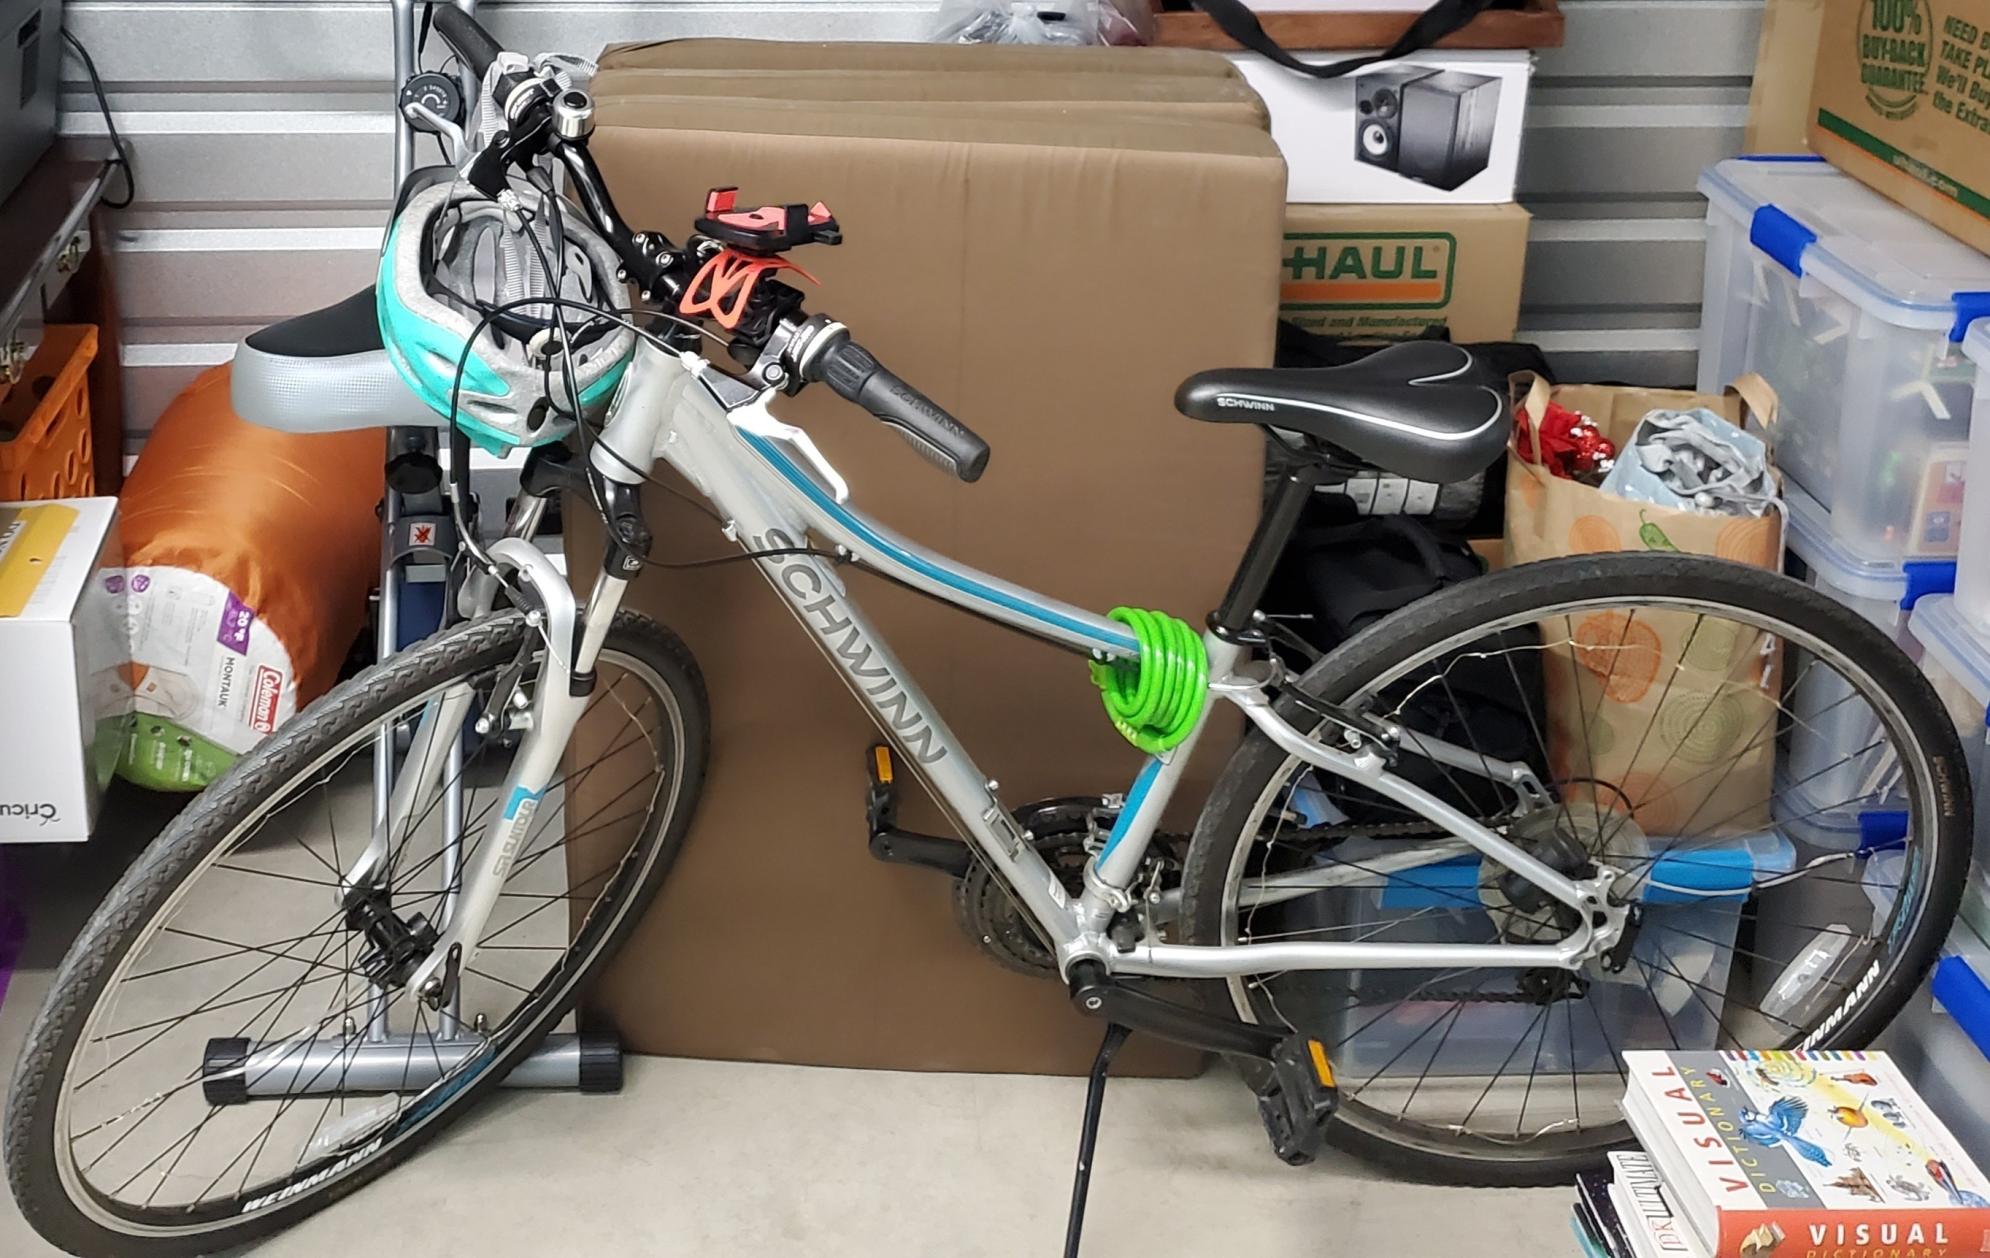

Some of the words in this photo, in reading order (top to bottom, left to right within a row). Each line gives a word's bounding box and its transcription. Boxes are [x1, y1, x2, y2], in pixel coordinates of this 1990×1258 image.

[1872, 0, 1921, 35] 100%
[1944, 15, 1978, 45] NEED
[1940, 40, 1972, 69] TAKE
[1973, 55, 1990, 80] PL
[1282, 246, 1438, 280] -HAUL
[1217, 397, 1275, 411] SCHWINN
[237, 610, 250, 627] 20
[753, 527, 948, 764] SCHWINN
[217, 656, 235, 708] MONTAUK
[255, 669, 282, 722] Coleman
[0, 803, 61, 827] Cricu
[1798, 959, 1881, 1051] INMANN
[1652, 1066, 1749, 1192] VISUAL
[1679, 1066, 1777, 1193] DICTIONARY
[1808, 1222, 1949, 1247] VISUAL
